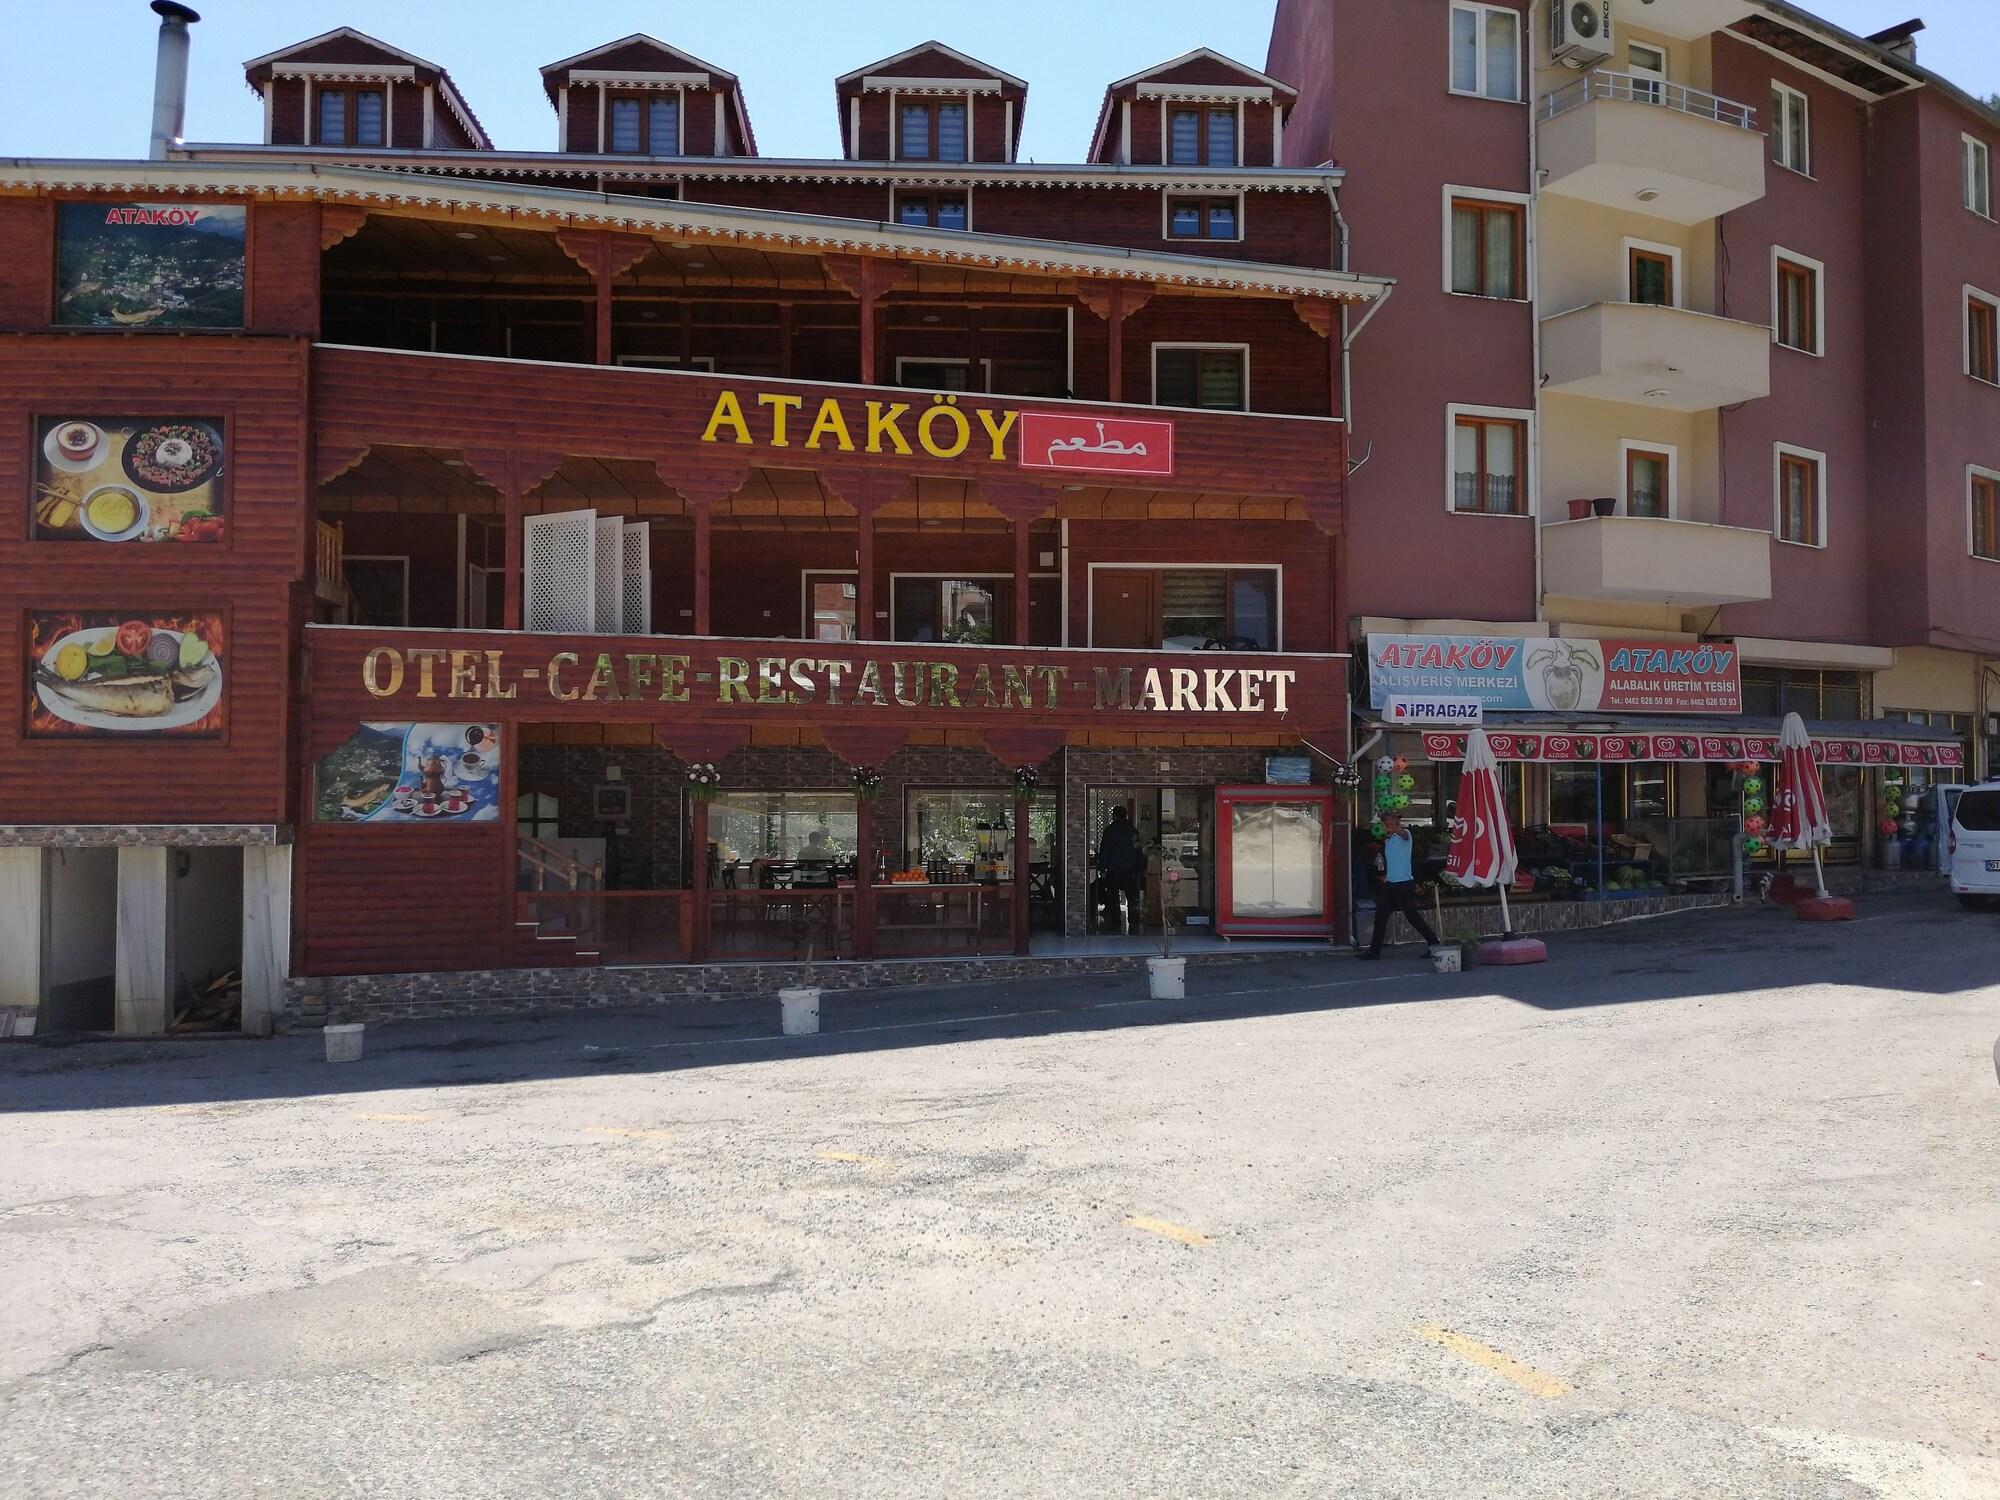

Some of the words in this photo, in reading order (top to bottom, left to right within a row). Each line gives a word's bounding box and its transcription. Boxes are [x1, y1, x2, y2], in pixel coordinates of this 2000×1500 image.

[105, 207, 199, 225] ATAKÖY
[701, 390, 1019, 461] ATAKÖY
[1047, 421, 1147, 466] مطعم
[1376, 639, 1517, 671] ATAKÖY
[1609, 645, 1733, 675] ATAKÖY
[1457, 675, 1518, 689] MERKEZİ
[1610, 680, 1661, 692] ALABALIK
[1663, 679, 1701, 692] ÜRETİM
[1704, 680, 1735, 692] TESİSİ
[1655, 697, 1663, 705] 50
[1705, 698, 1718, 706] 626
[1719, 698, 1727, 706] 52
